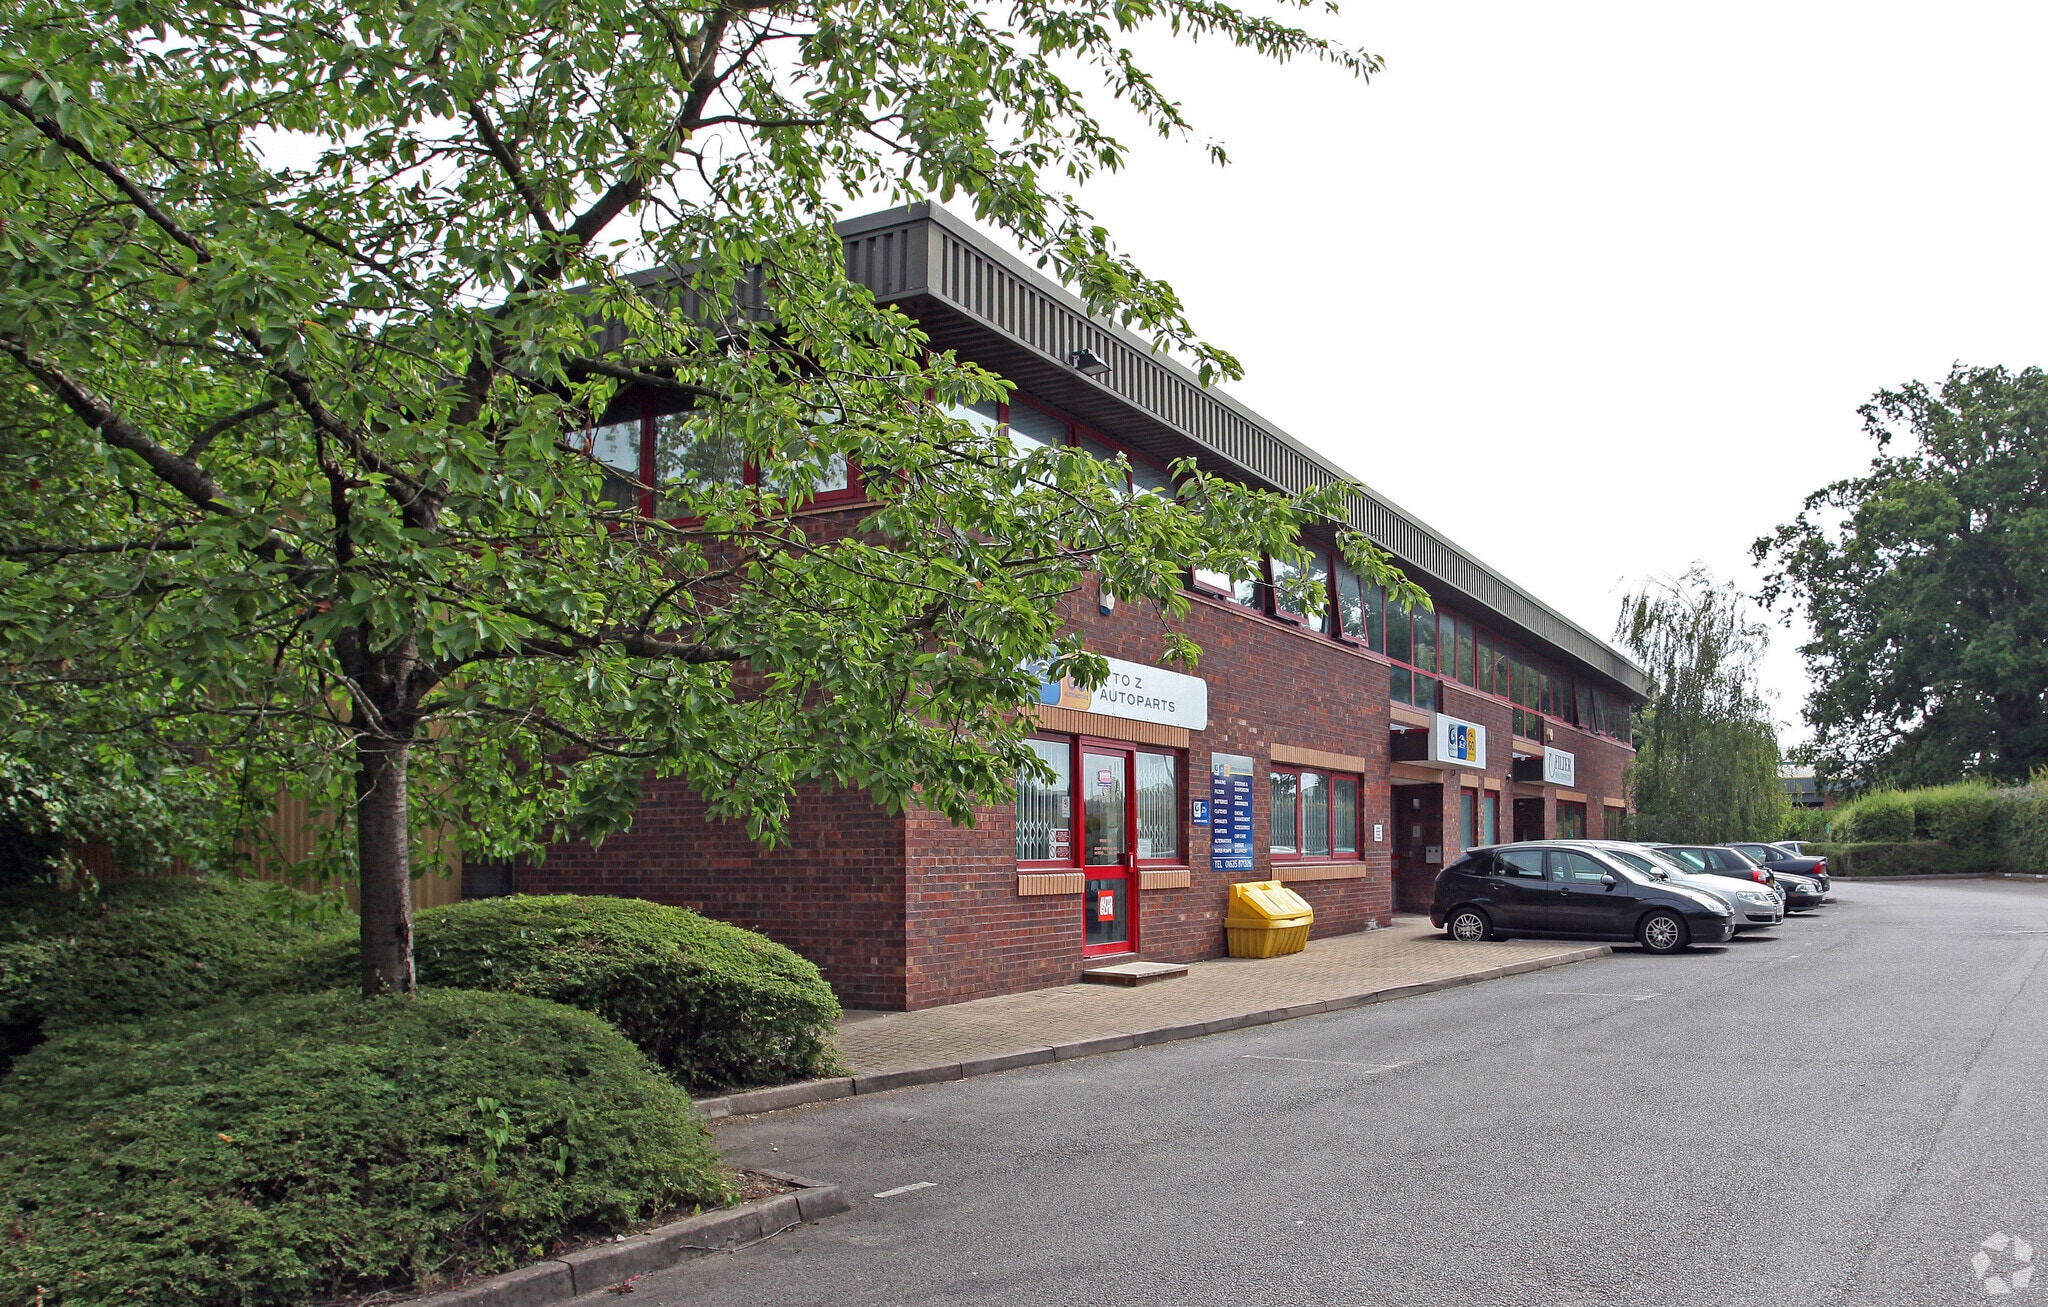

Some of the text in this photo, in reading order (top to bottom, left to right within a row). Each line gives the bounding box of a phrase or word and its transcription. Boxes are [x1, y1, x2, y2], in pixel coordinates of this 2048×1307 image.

[1112, 672, 1131, 687] TO
[1135, 677, 1143, 689] Z
[1100, 688, 1176, 713] AUTOPARTS
[1555, 754, 1572, 773] FILTER
[1214, 860, 1223, 868] TEL
